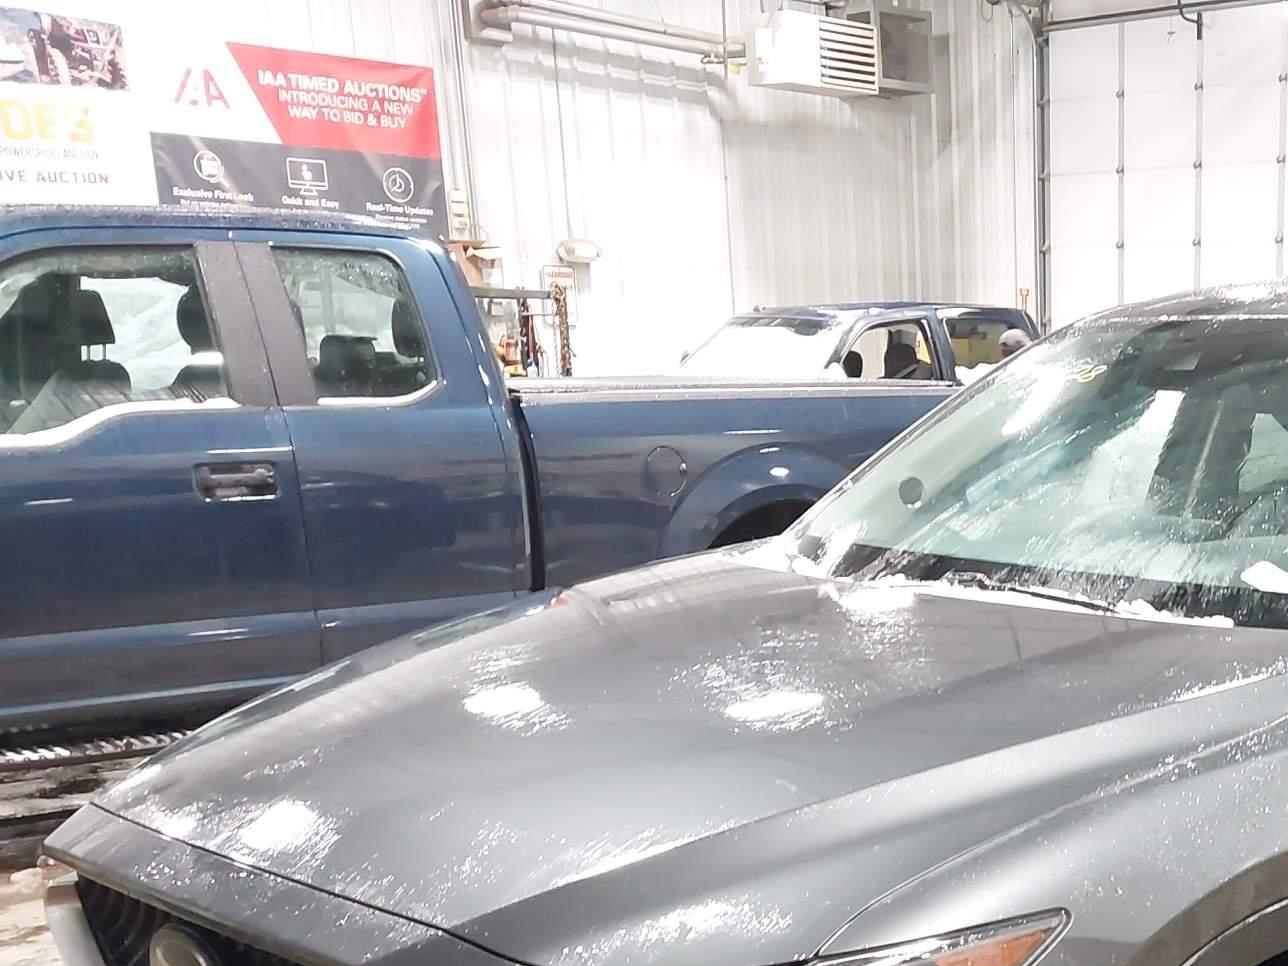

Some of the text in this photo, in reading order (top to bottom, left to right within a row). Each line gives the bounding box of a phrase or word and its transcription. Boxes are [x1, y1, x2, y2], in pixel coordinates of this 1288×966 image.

[257, 69, 287, 87] IAA
[287, 73, 340, 93] TIMED
[278, 89, 414, 116] INTRODUCING A NEW
[288, 105, 407, 129] WAY TO BID & BUY
[36, 171, 109, 184] AUCTION
[172, 186, 213, 199] Exclusive
[281, 195, 303, 207] Quick
[304, 198, 320, 207] and
[321, 199, 340, 210] Easy
[366, 202, 434, 217] Real-Time Updates
